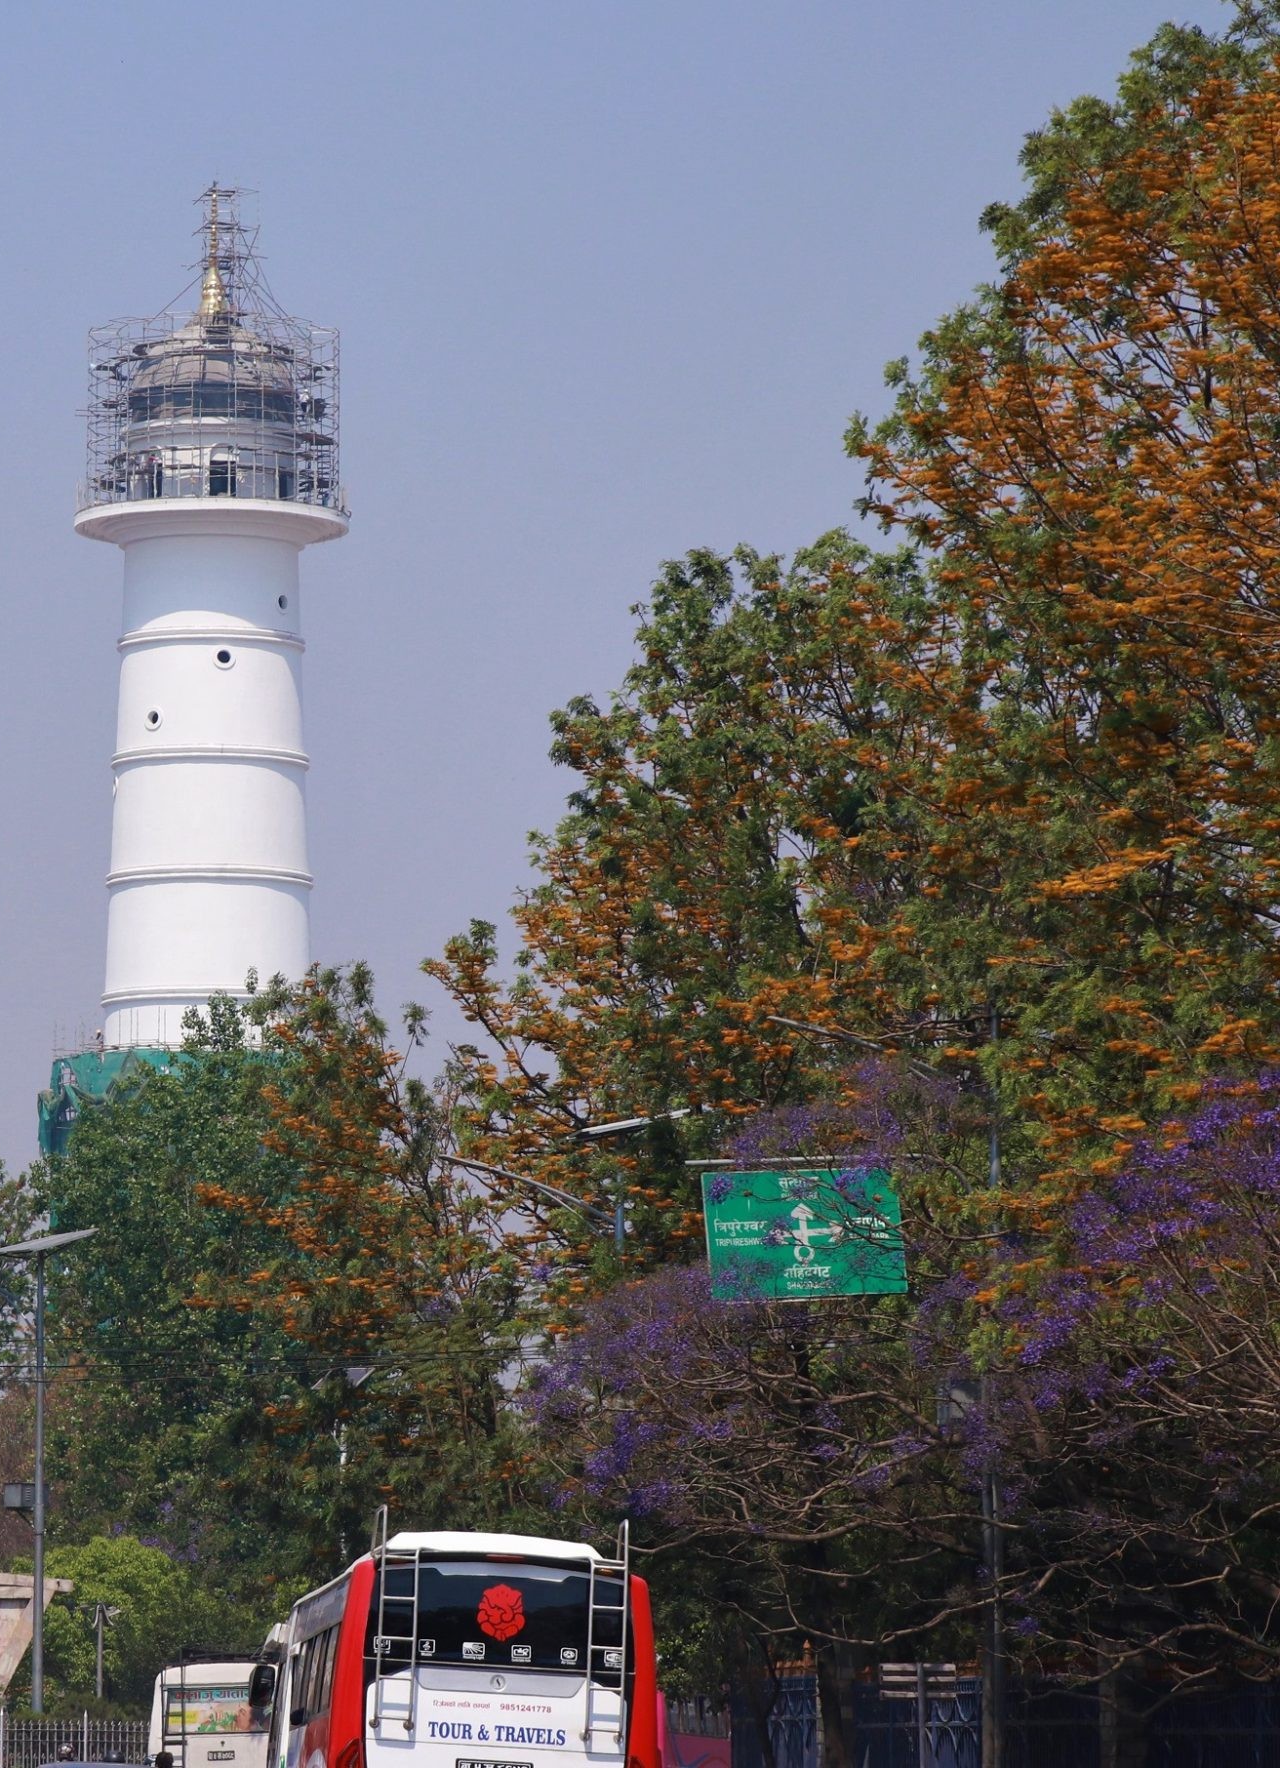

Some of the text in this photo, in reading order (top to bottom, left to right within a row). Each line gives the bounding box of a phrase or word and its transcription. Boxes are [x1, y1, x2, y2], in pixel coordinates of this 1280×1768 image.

[500, 1703, 552, 1713] 9851241778
[428, 1721, 566, 1746] TOUR & TRAVELS
